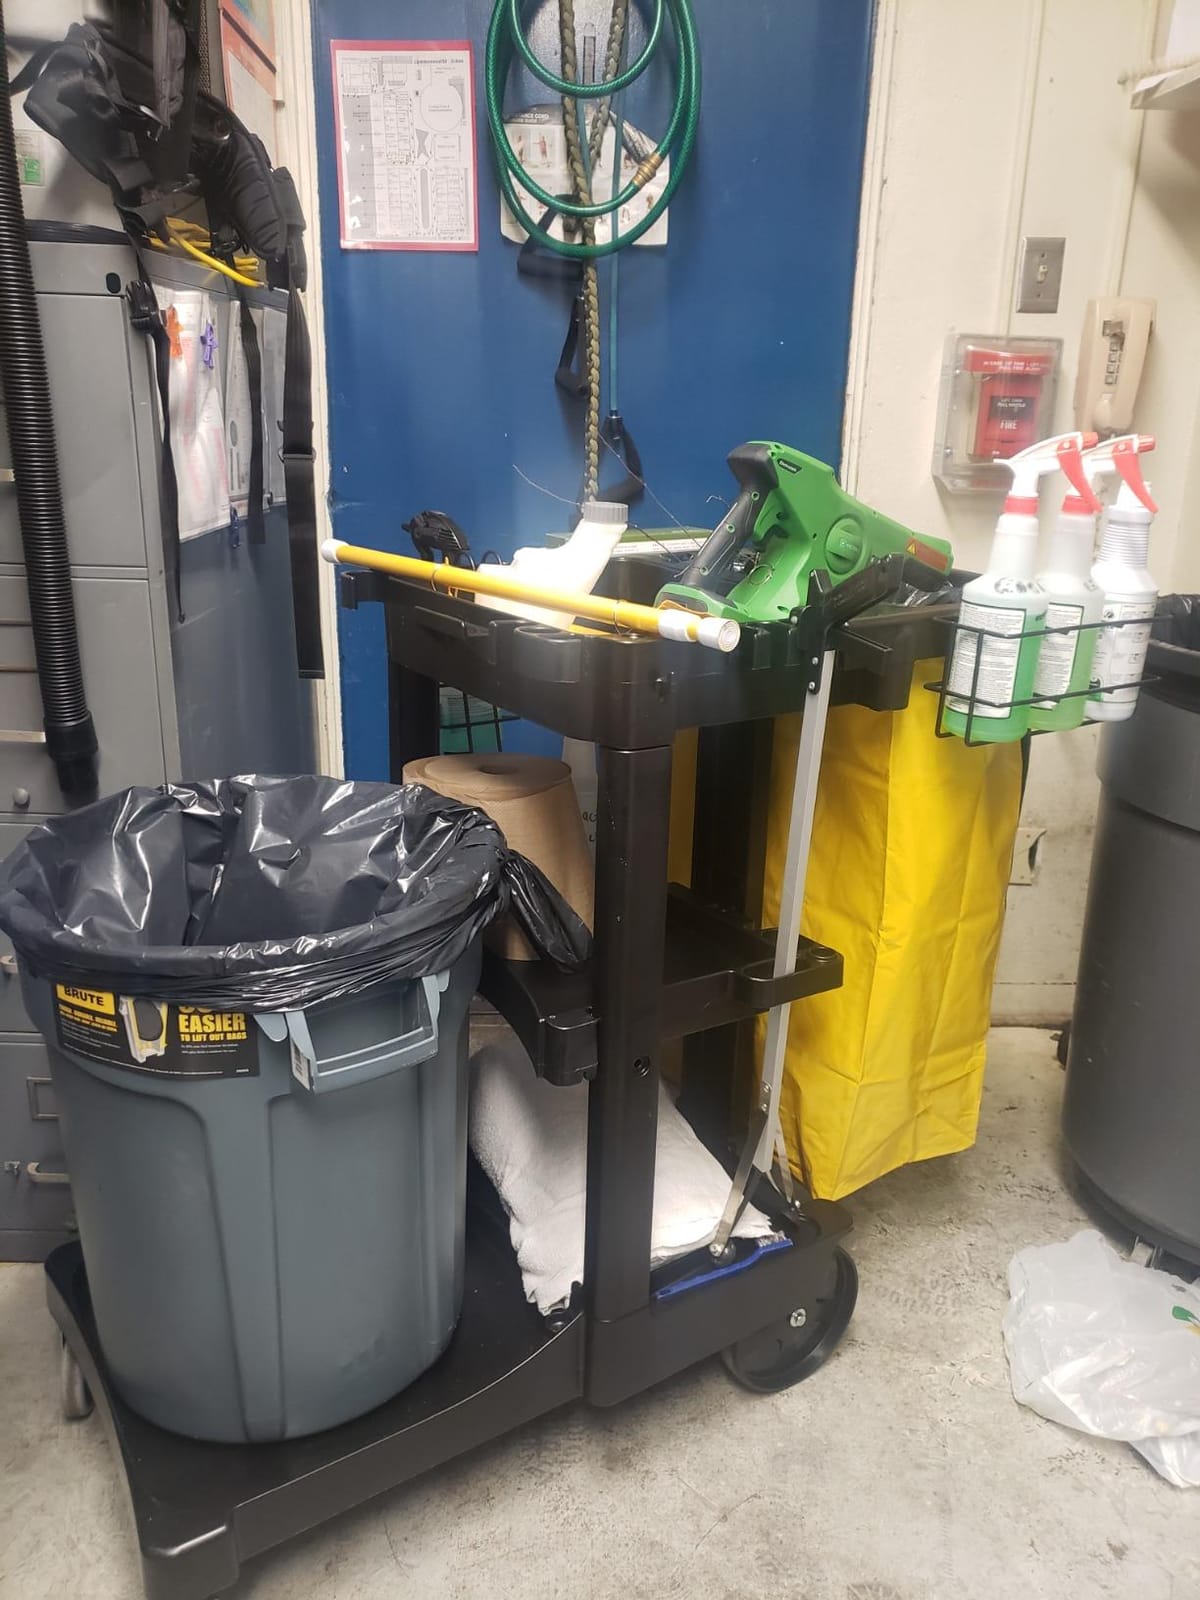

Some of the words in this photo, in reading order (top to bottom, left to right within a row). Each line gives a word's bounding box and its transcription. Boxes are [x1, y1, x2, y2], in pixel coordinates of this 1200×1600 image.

[1000, 420, 1017, 430] FIRE
[64, 987, 104, 1006] BRUTE
[178, 1012, 246, 1033] EASIER
[180, 1034, 191, 1042] TO
[192, 1034, 207, 1042] LIFT
[208, 1033, 224, 1041] OUT
[226, 1031, 247, 1040] BAGS
